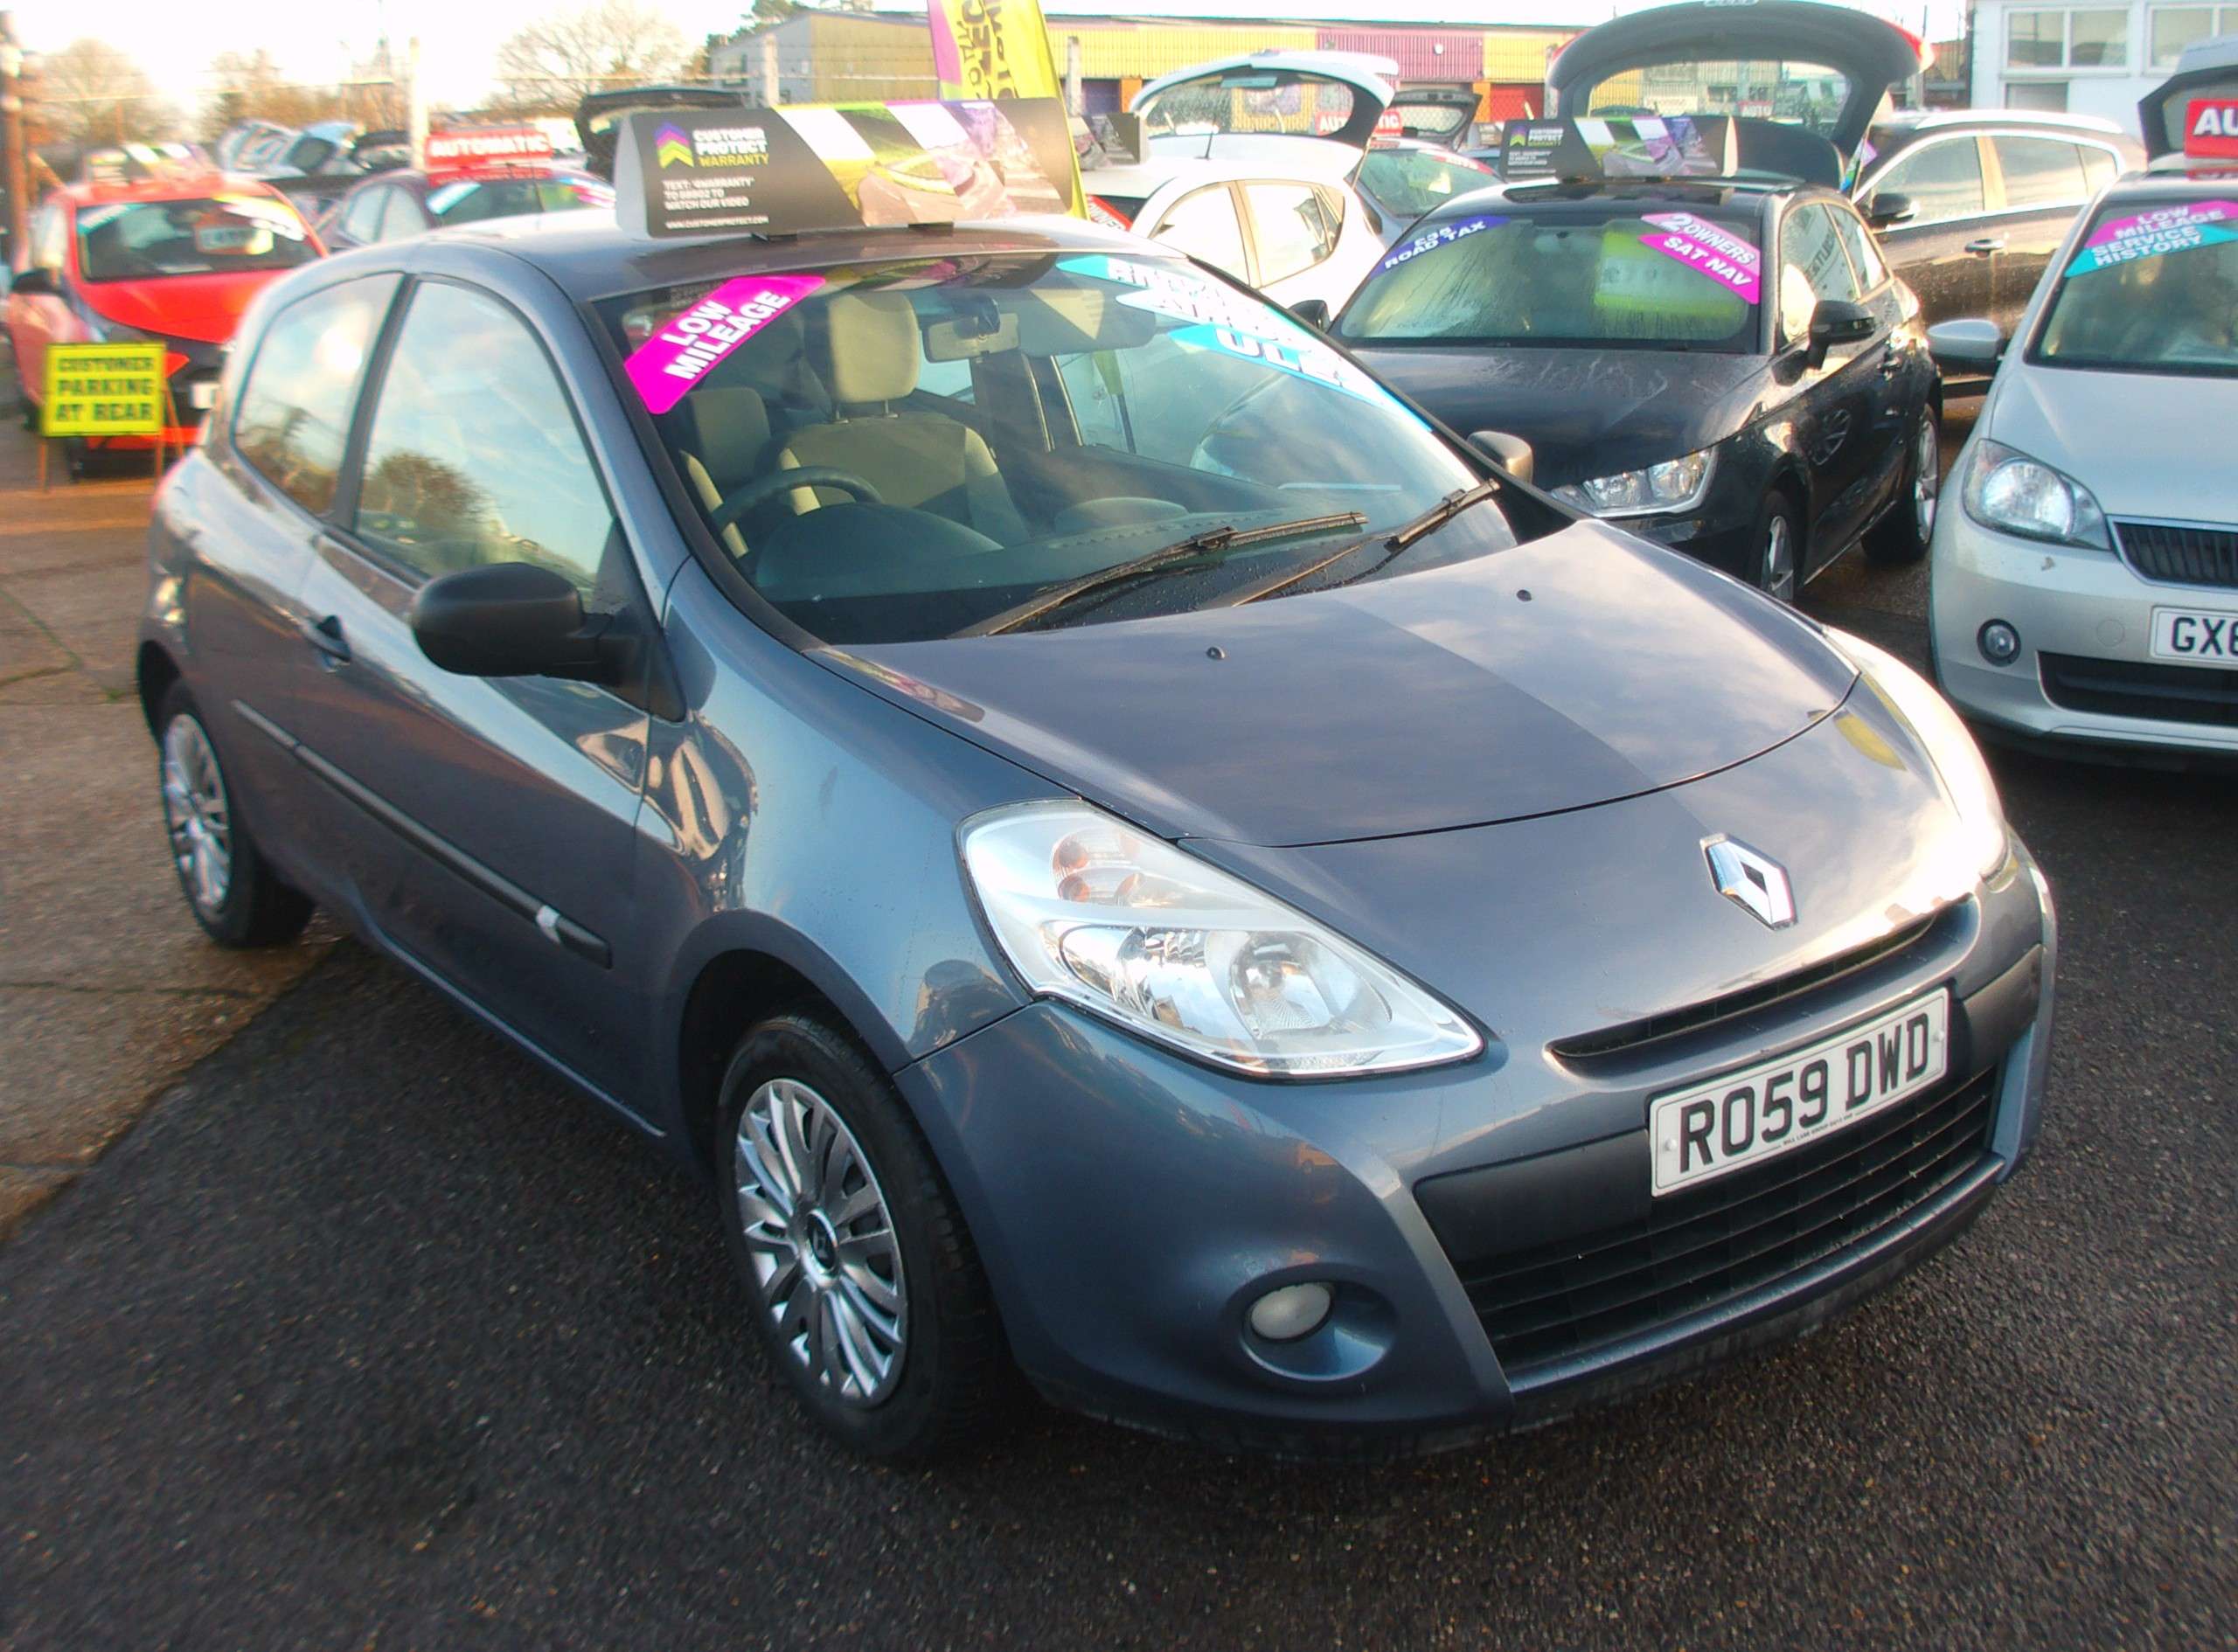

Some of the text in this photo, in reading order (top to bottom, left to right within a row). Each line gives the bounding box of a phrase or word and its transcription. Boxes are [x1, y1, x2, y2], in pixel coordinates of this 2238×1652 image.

[430, 135, 549, 157] AUTOMATIC
[692, 127, 766, 142] CUSTOMER
[694, 139, 768, 156] PROTECT
[699, 152, 769, 168] WARRANTY
[2114, 210, 2226, 240] MILEAGE
[2137, 205, 2189, 225] LOW
[1384, 219, 1487, 270] ROAD TAX
[1684, 224, 1756, 266] OWNERS
[2091, 226, 2198, 257] SERVICE
[2095, 233, 2202, 267] HISTORY
[1663, 236, 1753, 286] SAT NAV
[660, 299, 733, 347] LOW
[662, 289, 792, 381] MILEAGE
[56, 378, 154, 396] PARKING
[56, 403, 153, 421] AT REAR
[1678, 1013, 1929, 1174] RO59 DWD
